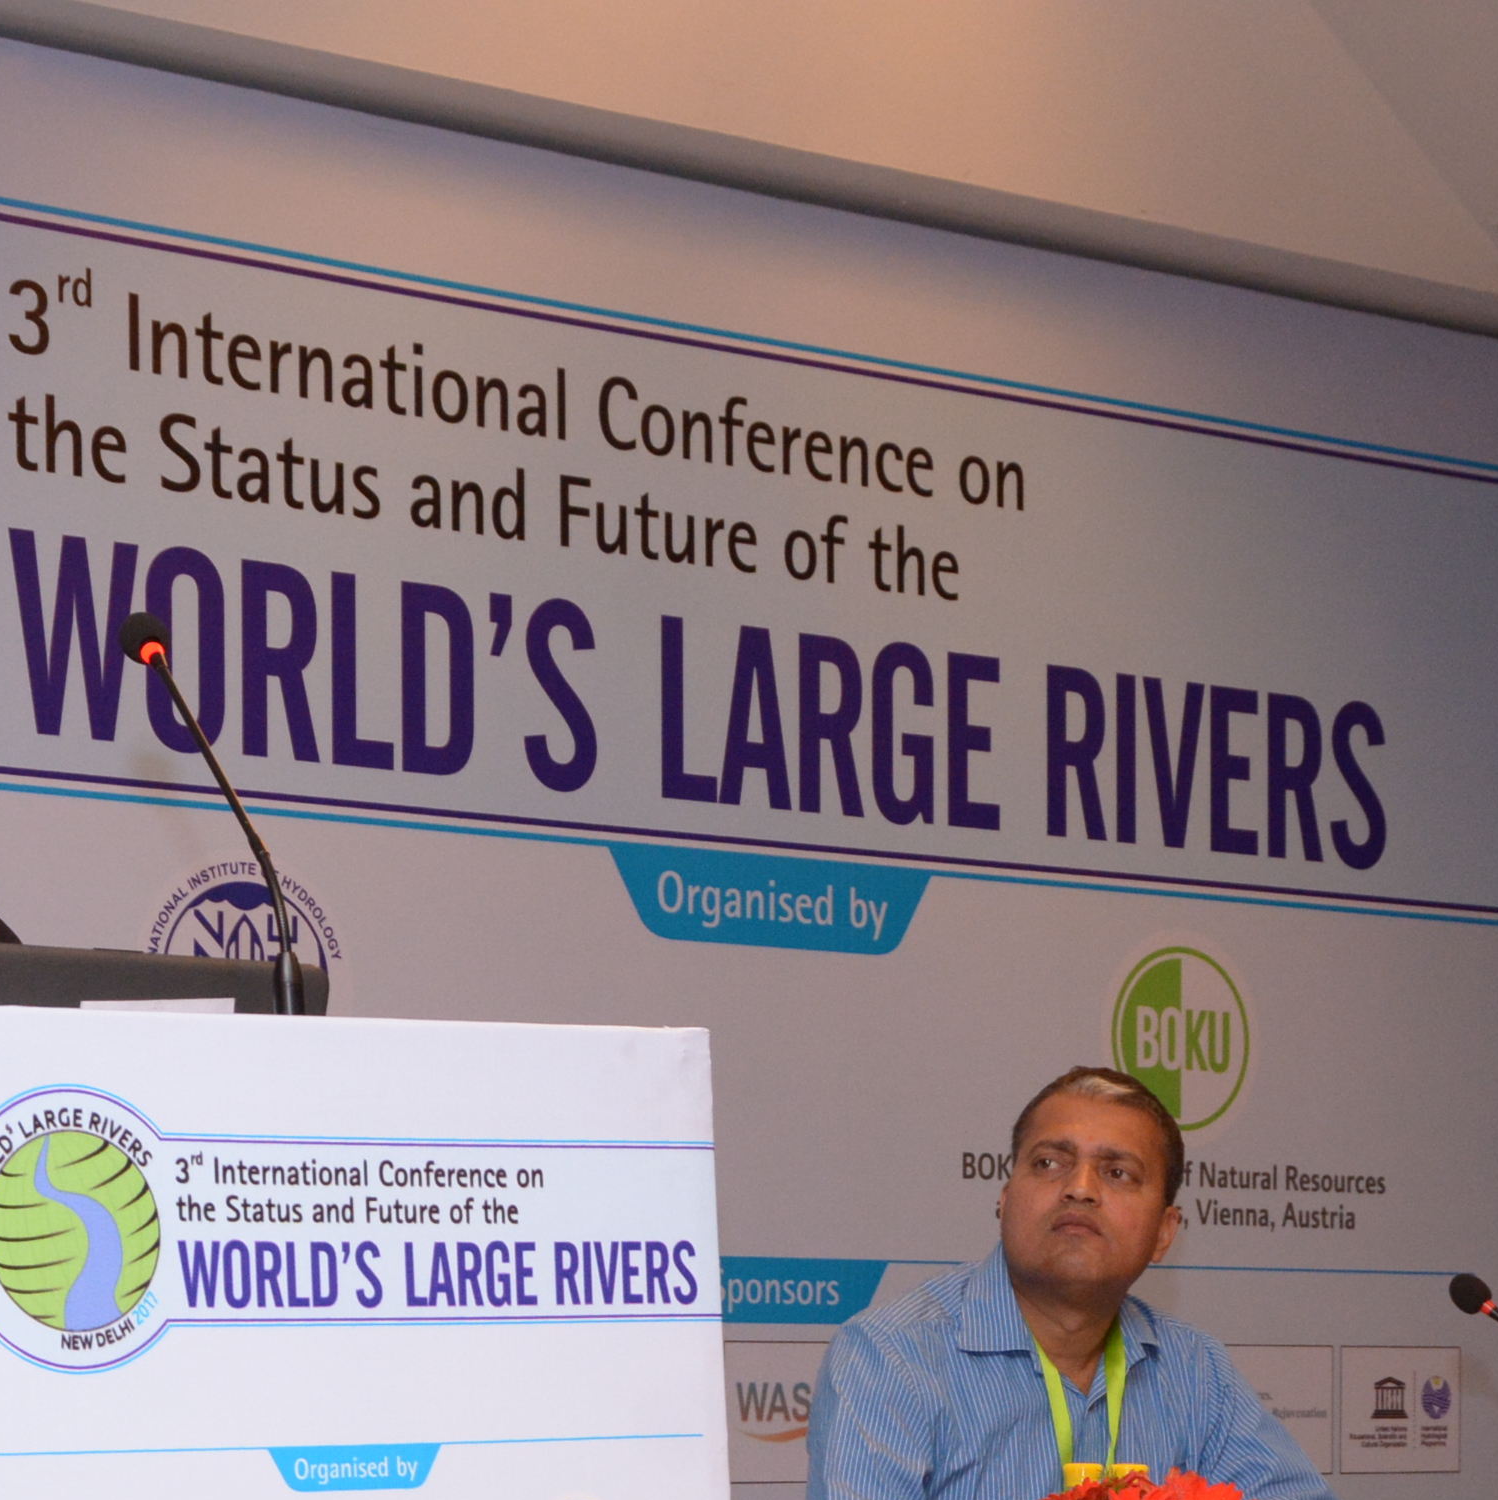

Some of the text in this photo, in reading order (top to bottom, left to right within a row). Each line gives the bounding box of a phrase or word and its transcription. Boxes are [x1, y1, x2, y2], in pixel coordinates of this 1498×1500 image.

[127, 291, 568, 441] International
[597, 376, 934, 498] Conference
[959, 457, 1025, 511] on
[7, 393, 959, 601] the Status and Future of the
[661, 615, 1001, 832] LARGE
[1046, 664, 1387, 870] RIVERS
[187, 862, 256, 890] INSTITUTE
[657, 869, 888, 939] Organised by
[281, 875, 342, 960] HYDROLOGY
[1135, 1006, 1230, 1072] BOKU
[18, 1108, 83, 1138] LARGE
[89, 1112, 153, 1167] RIVERS
[213, 1157, 368, 1187] International
[379, 1160, 507, 1188] Conference
[516, 1167, 544, 1188] on
[962, 1152, 1012, 1181] BOK
[1201, 1163, 1277, 1191] Natural
[1285, 1165, 1387, 1194] Resources
[176, 1195, 519, 1225] the Status and Future of the
[1197, 1200, 1277, 1232] Vienna,
[1282, 1203, 1355, 1230] Austria
[177, 1239, 698, 1309] WORLD'S LARGE RIVERS
[61, 1291, 159, 1350] NEW DELHI 2017
[294, 1456, 418, 1485] Organised by
